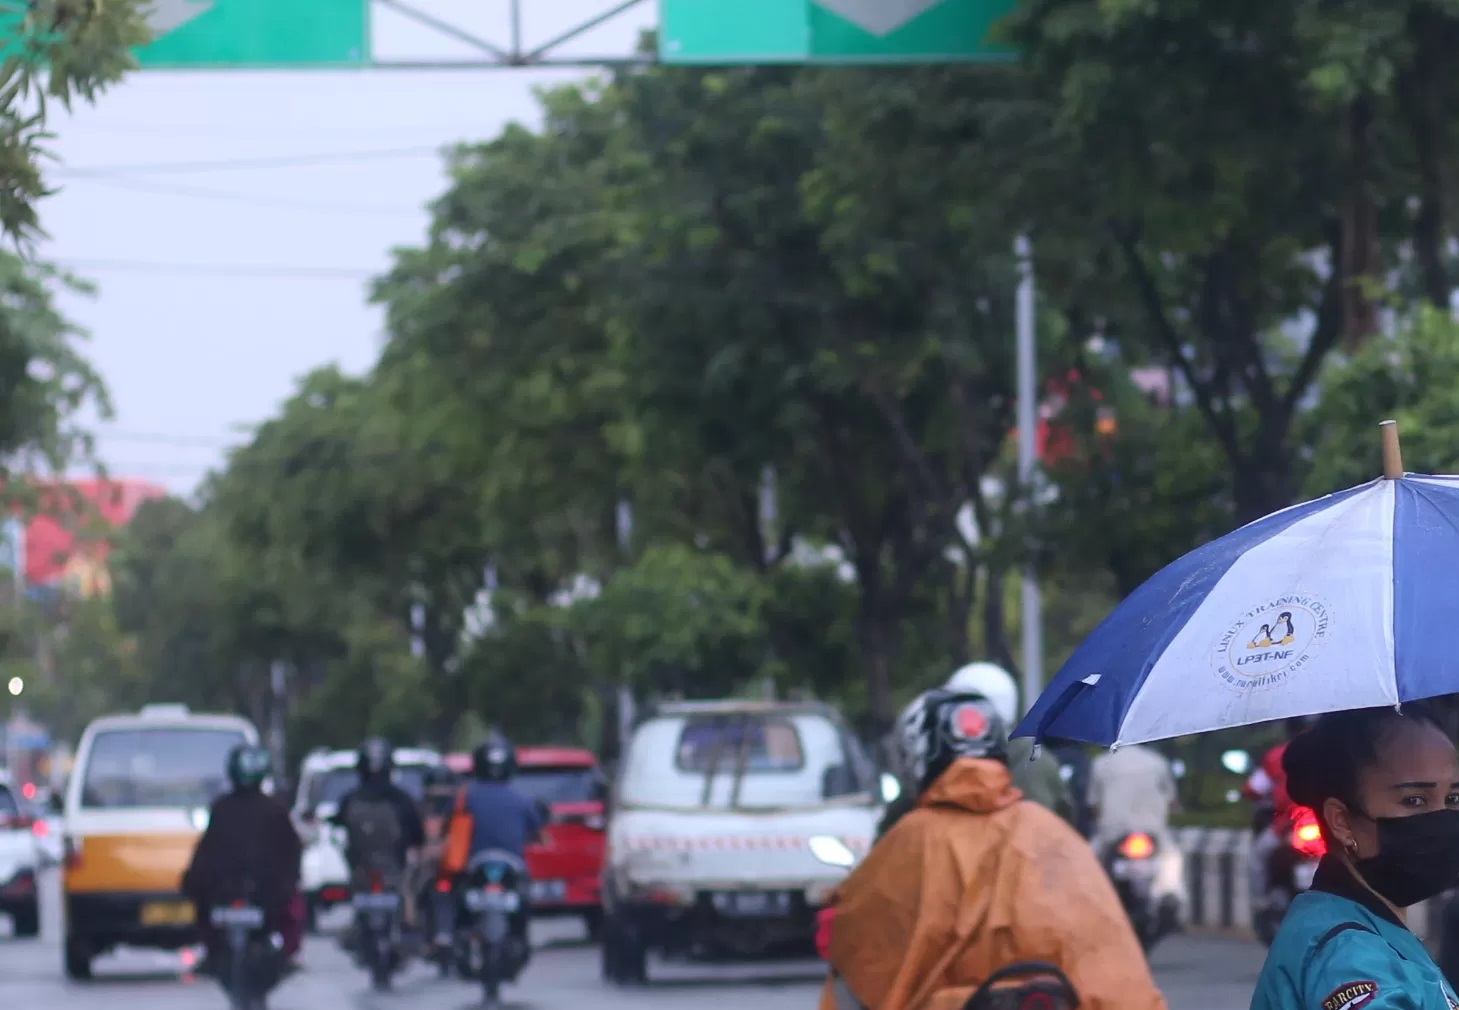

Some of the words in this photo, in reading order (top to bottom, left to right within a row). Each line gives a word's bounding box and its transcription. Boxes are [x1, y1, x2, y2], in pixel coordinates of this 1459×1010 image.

[1217, 620, 1245, 653] LINUX
[1246, 596, 1309, 618] TRAINING
[1309, 601, 1329, 639] CENTRE
[1236, 649, 1295, 666] LP3T-NF
